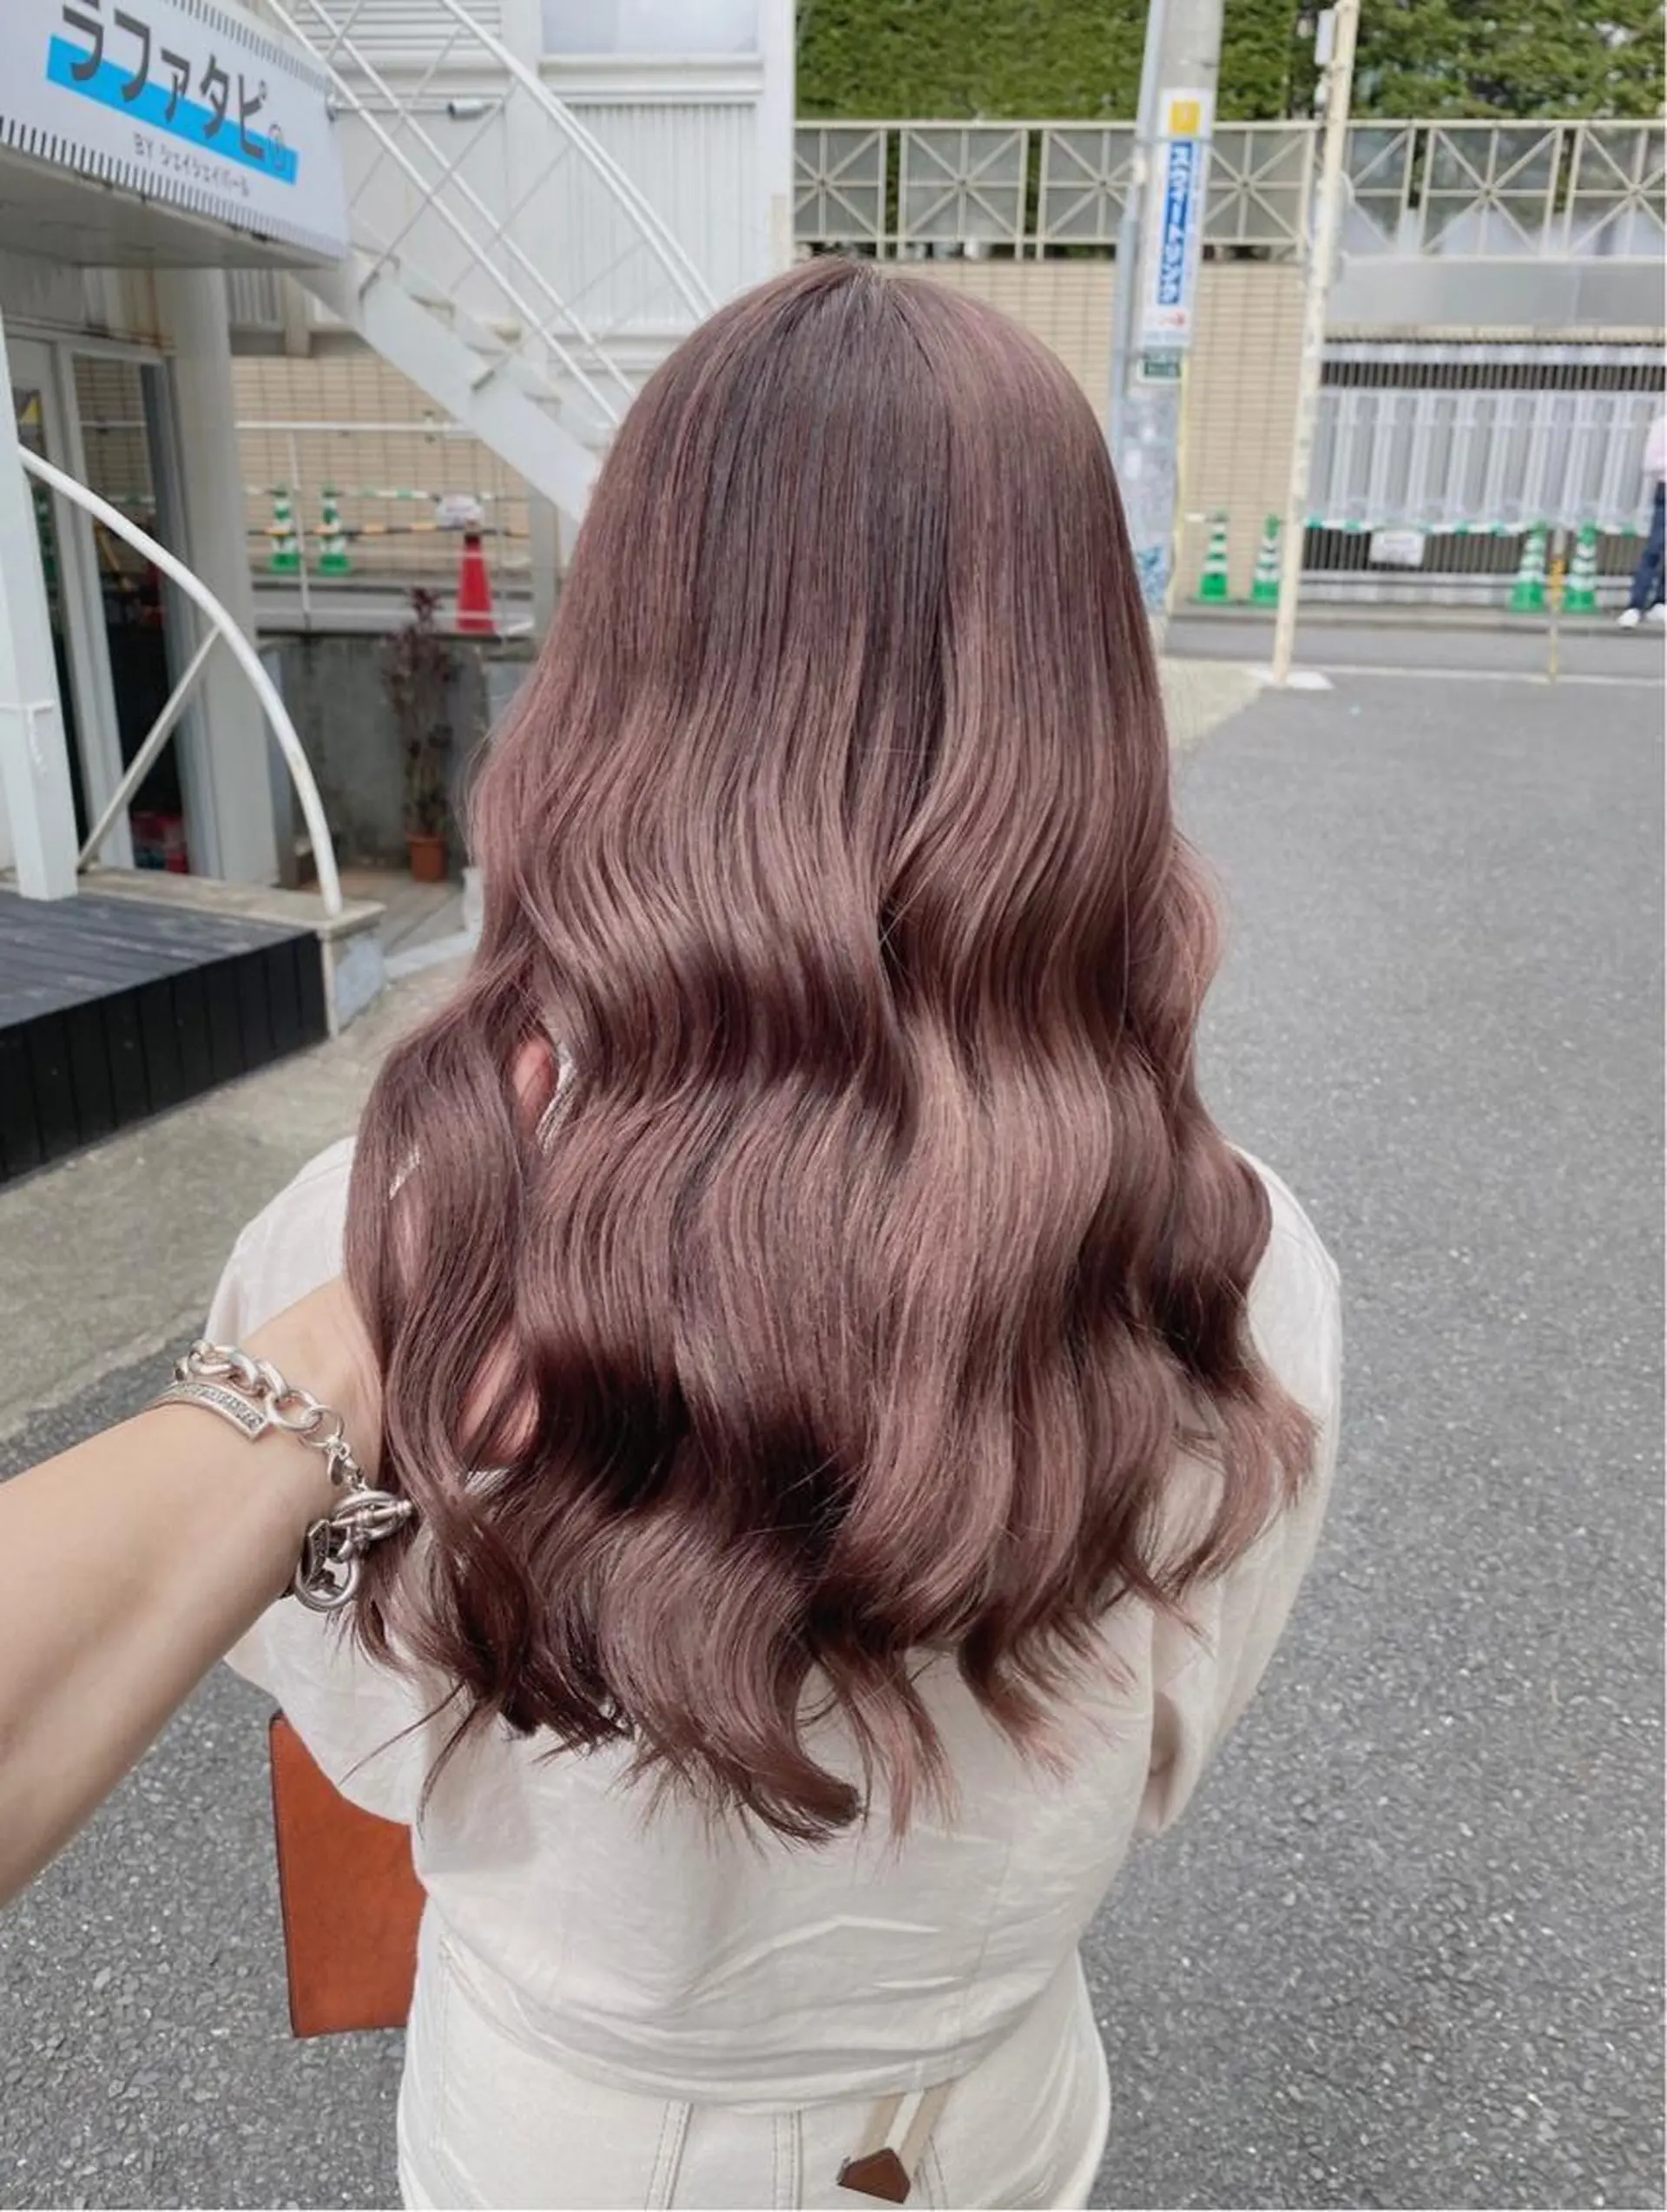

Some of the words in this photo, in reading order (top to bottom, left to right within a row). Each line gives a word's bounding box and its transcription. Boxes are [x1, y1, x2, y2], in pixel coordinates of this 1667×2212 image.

[62, 0, 267, 160] ラファタピ
